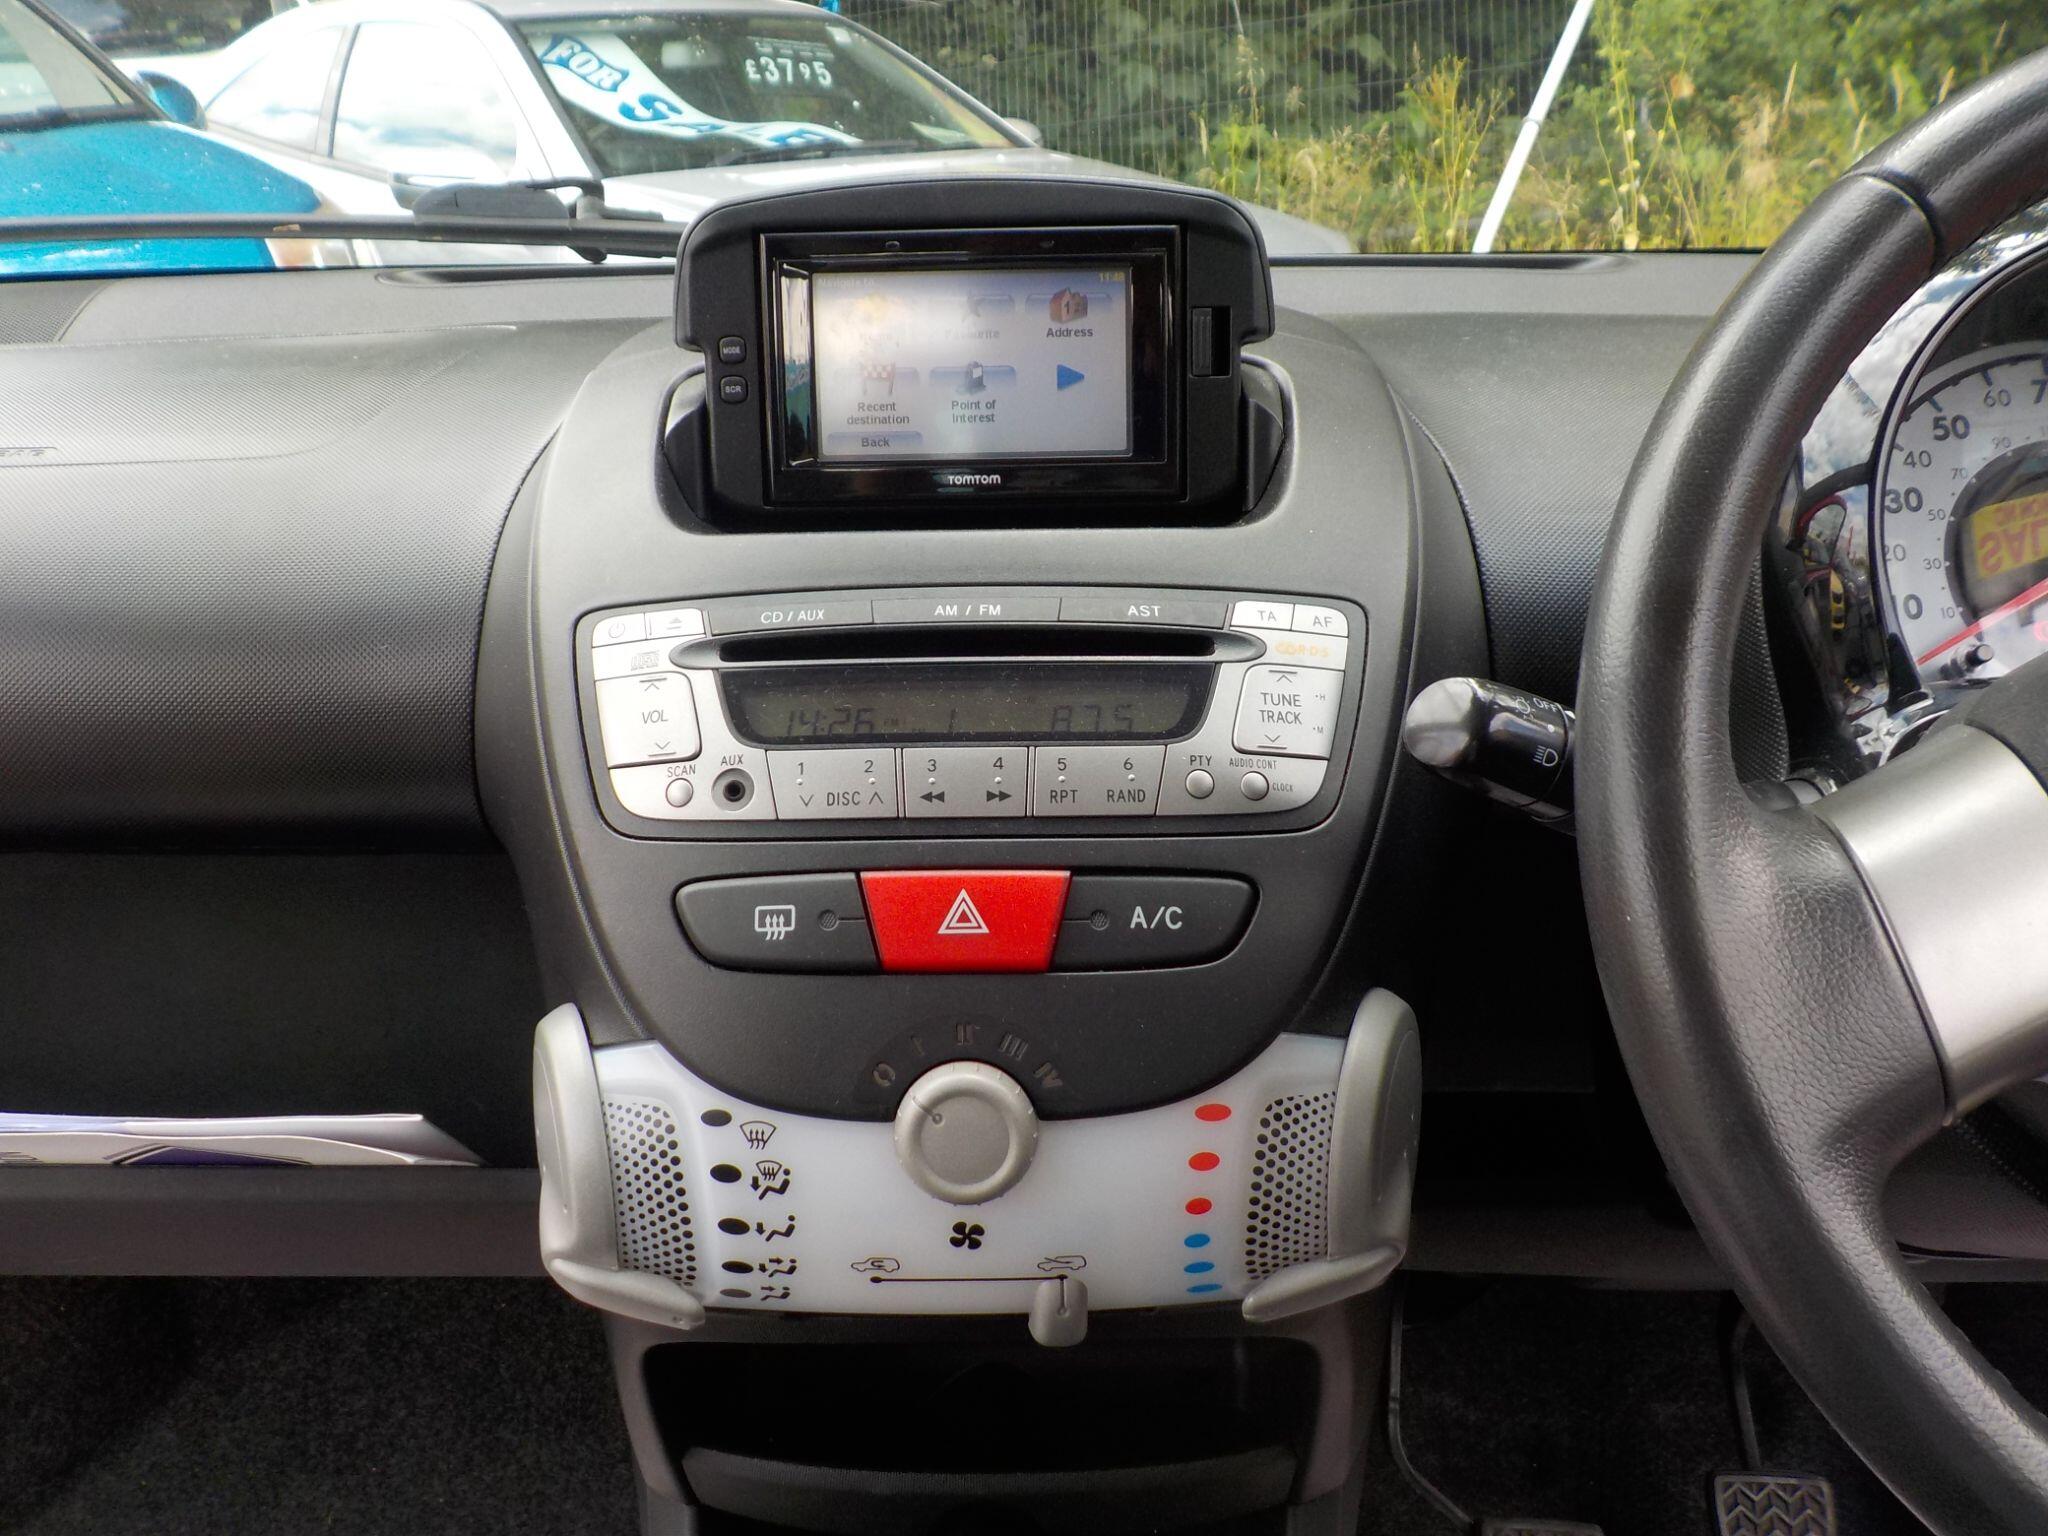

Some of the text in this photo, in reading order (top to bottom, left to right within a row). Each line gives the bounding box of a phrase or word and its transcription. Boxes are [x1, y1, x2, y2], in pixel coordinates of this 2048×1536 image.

[542, 36, 627, 92] FOR
[745, 56, 832, 85] £3795
[1046, 328, 1094, 338] Address
[725, 385, 742, 393] SCR
[1983, 388, 2011, 407] 60
[857, 401, 896, 412] Recent
[951, 399, 996, 411] Point of
[847, 413, 910, 425] destination
[952, 412, 996, 423] Interest
[1932, 414, 1970, 441] 50
[861, 437, 890, 448] Back
[1902, 450, 1932, 469] 40
[1884, 486, 1923, 514] 30
[1927, 508, 1946, 521] 50
[1922, 558, 1942, 570] 30
[934, 605, 957, 616] AM
[979, 605, 1001, 616] FM
[1127, 605, 1161, 617] AST
[1902, 593, 1923, 620] 0
[1941, 606, 1956, 619] 10
[761, 611, 784, 624] CD
[798, 609, 825, 622] AUX
[1257, 609, 1278, 622] TA
[1312, 615, 1333, 628] AF
[1260, 692, 1302, 708] TUNE
[1533, 697, 1558, 712] OFF
[641, 710, 669, 724] VOL
[1259, 709, 1303, 725] TRACK
[720, 754, 744, 767] AUX
[864, 760, 873, 773] 2
[927, 759, 937, 772] 3
[992, 757, 1004, 770] 4
[1058, 757, 1067, 771] 5
[1123, 757, 1133, 771] 6
[1189, 754, 1213, 767] PTY
[1229, 757, 1277, 769] AUDIO CONT
[667, 763, 697, 778] SCAN
[798, 762, 804, 775] 1
[1272, 782, 1294, 792] CLOCK
[826, 791, 861, 807] DISC
[1050, 790, 1078, 804] RPT
[1107, 789, 1146, 804] RAND
[1130, 905, 1183, 930] A/C
